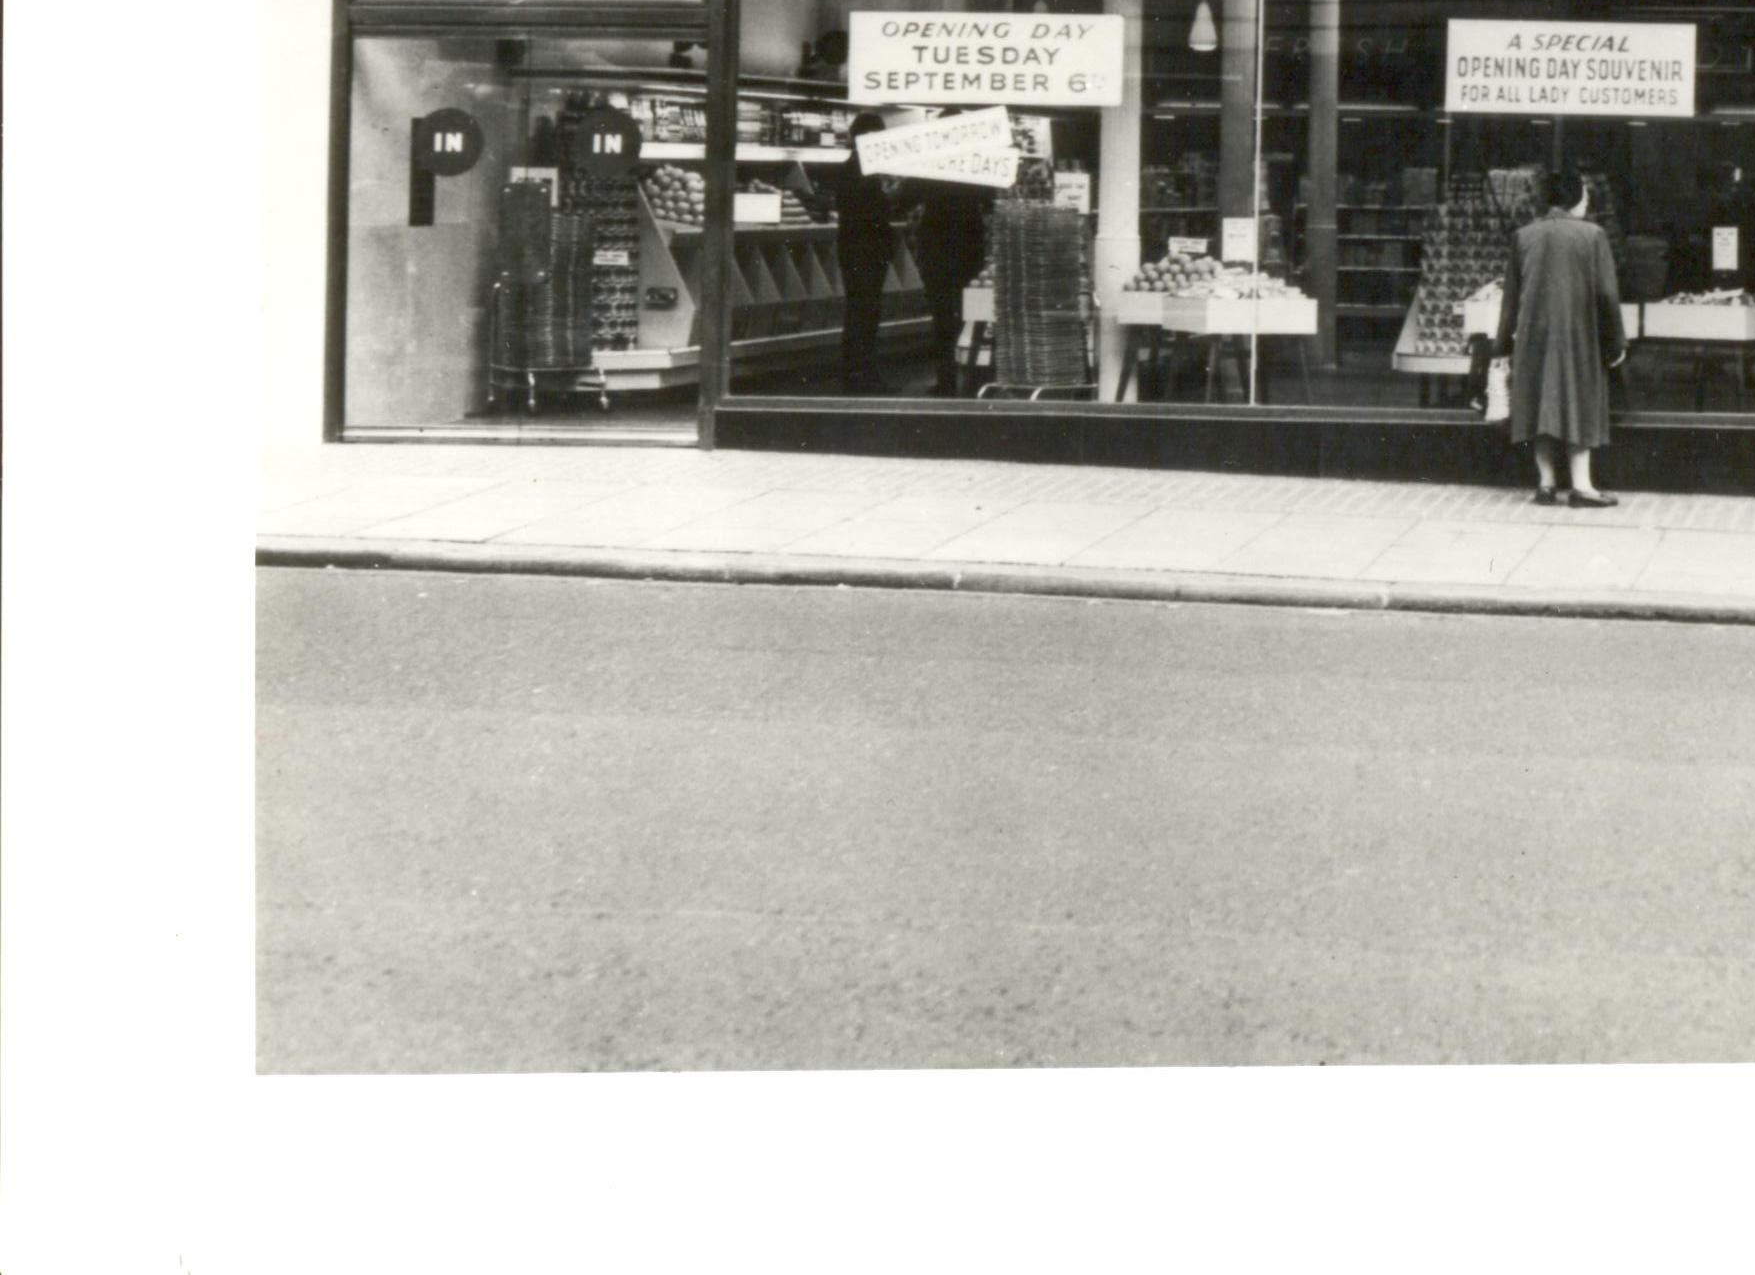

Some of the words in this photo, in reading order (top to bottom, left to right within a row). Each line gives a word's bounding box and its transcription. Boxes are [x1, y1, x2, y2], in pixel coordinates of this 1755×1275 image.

[881, 20, 1011, 40] OPENING
[1029, 22, 1095, 41] DAY
[1506, 33, 1523, 51] A
[1531, 33, 1632, 54] SPECIAL
[912, 45, 1062, 66] TUESDAY
[1456, 56, 1542, 79] OPENING
[1546, 57, 1582, 80] DAY
[1586, 58, 1684, 82] SOUVENIR
[863, 71, 1050, 93] SEPTEMBER
[1460, 84, 1491, 103] FOR
[1496, 85, 1522, 104] ALL
[1528, 86, 1570, 105] LADY
[1578, 86, 1680, 106] CUSTOMERS
[433, 131, 464, 153] IN
[592, 133, 623, 154] IN
